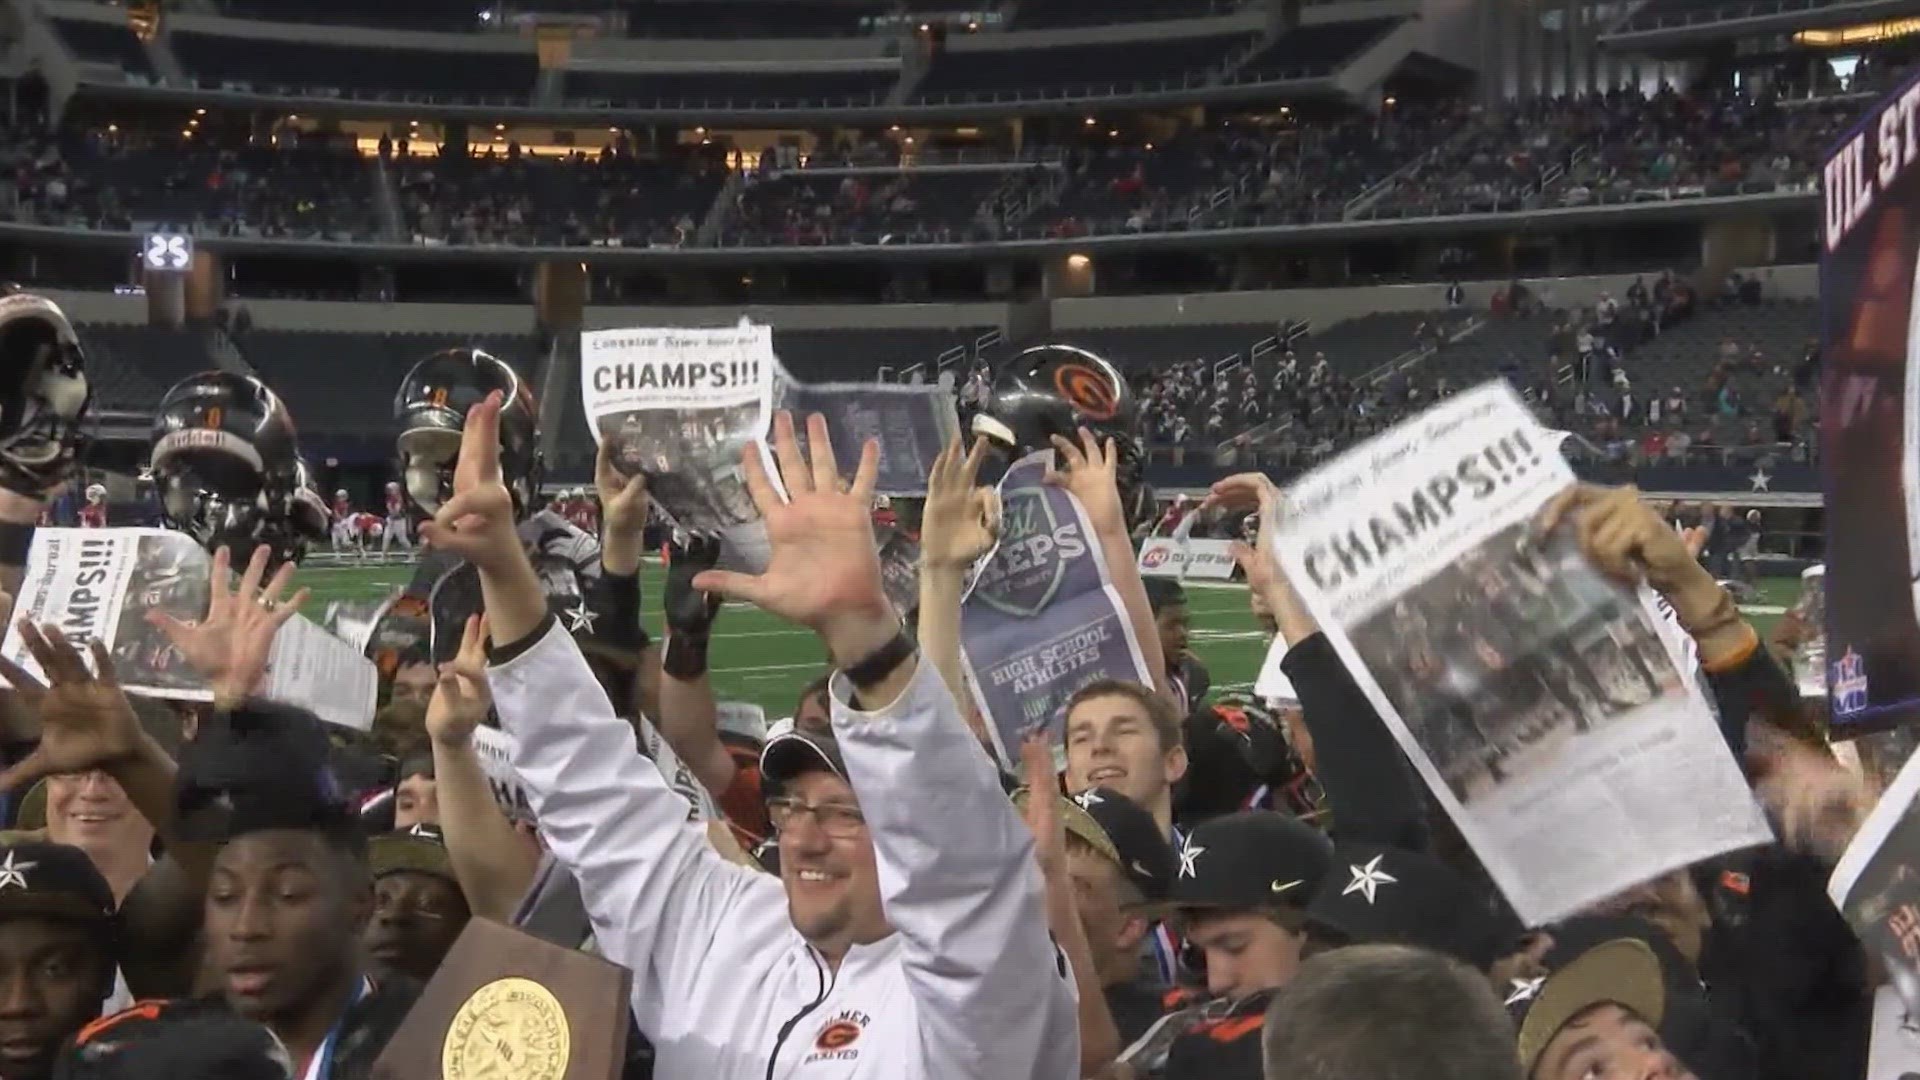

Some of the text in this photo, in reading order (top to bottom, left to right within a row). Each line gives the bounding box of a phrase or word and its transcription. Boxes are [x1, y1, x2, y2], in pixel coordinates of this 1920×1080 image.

[1825, 131, 1873, 252] UIL
[148, 236, 188, 267] 25
[593, 360, 759, 393] CHAMPS!!!
[1303, 428, 1541, 590] CHAMPS!!!
[991, 625, 1112, 687] HIGH SCHOOL
[1013, 645, 1100, 695] ATHLETES
